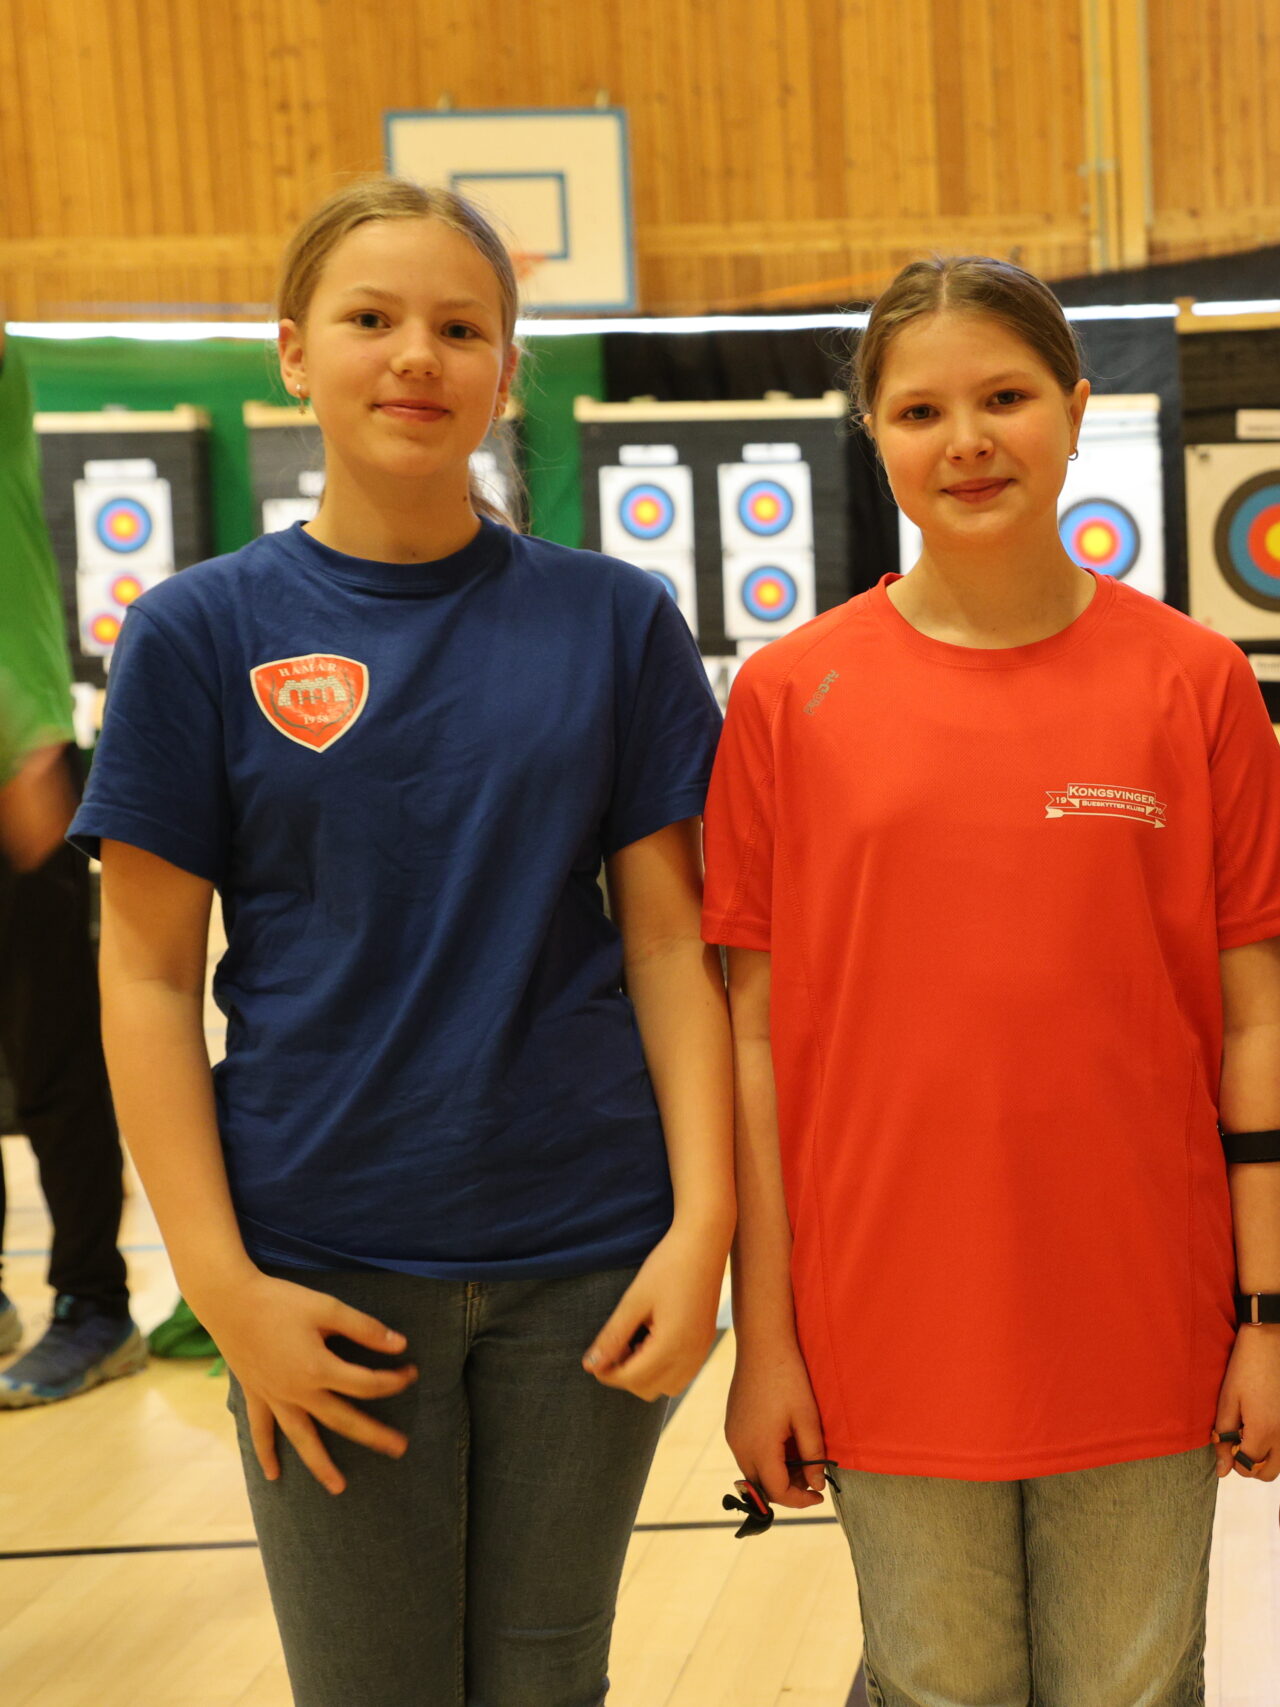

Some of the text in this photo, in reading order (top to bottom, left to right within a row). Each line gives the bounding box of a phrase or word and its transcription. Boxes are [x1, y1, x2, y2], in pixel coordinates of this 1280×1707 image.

[278, 662, 337, 677] HAMAR
[1056, 796, 1067, 804] 19
[1069, 786, 1156, 805] KONGSVINGER
